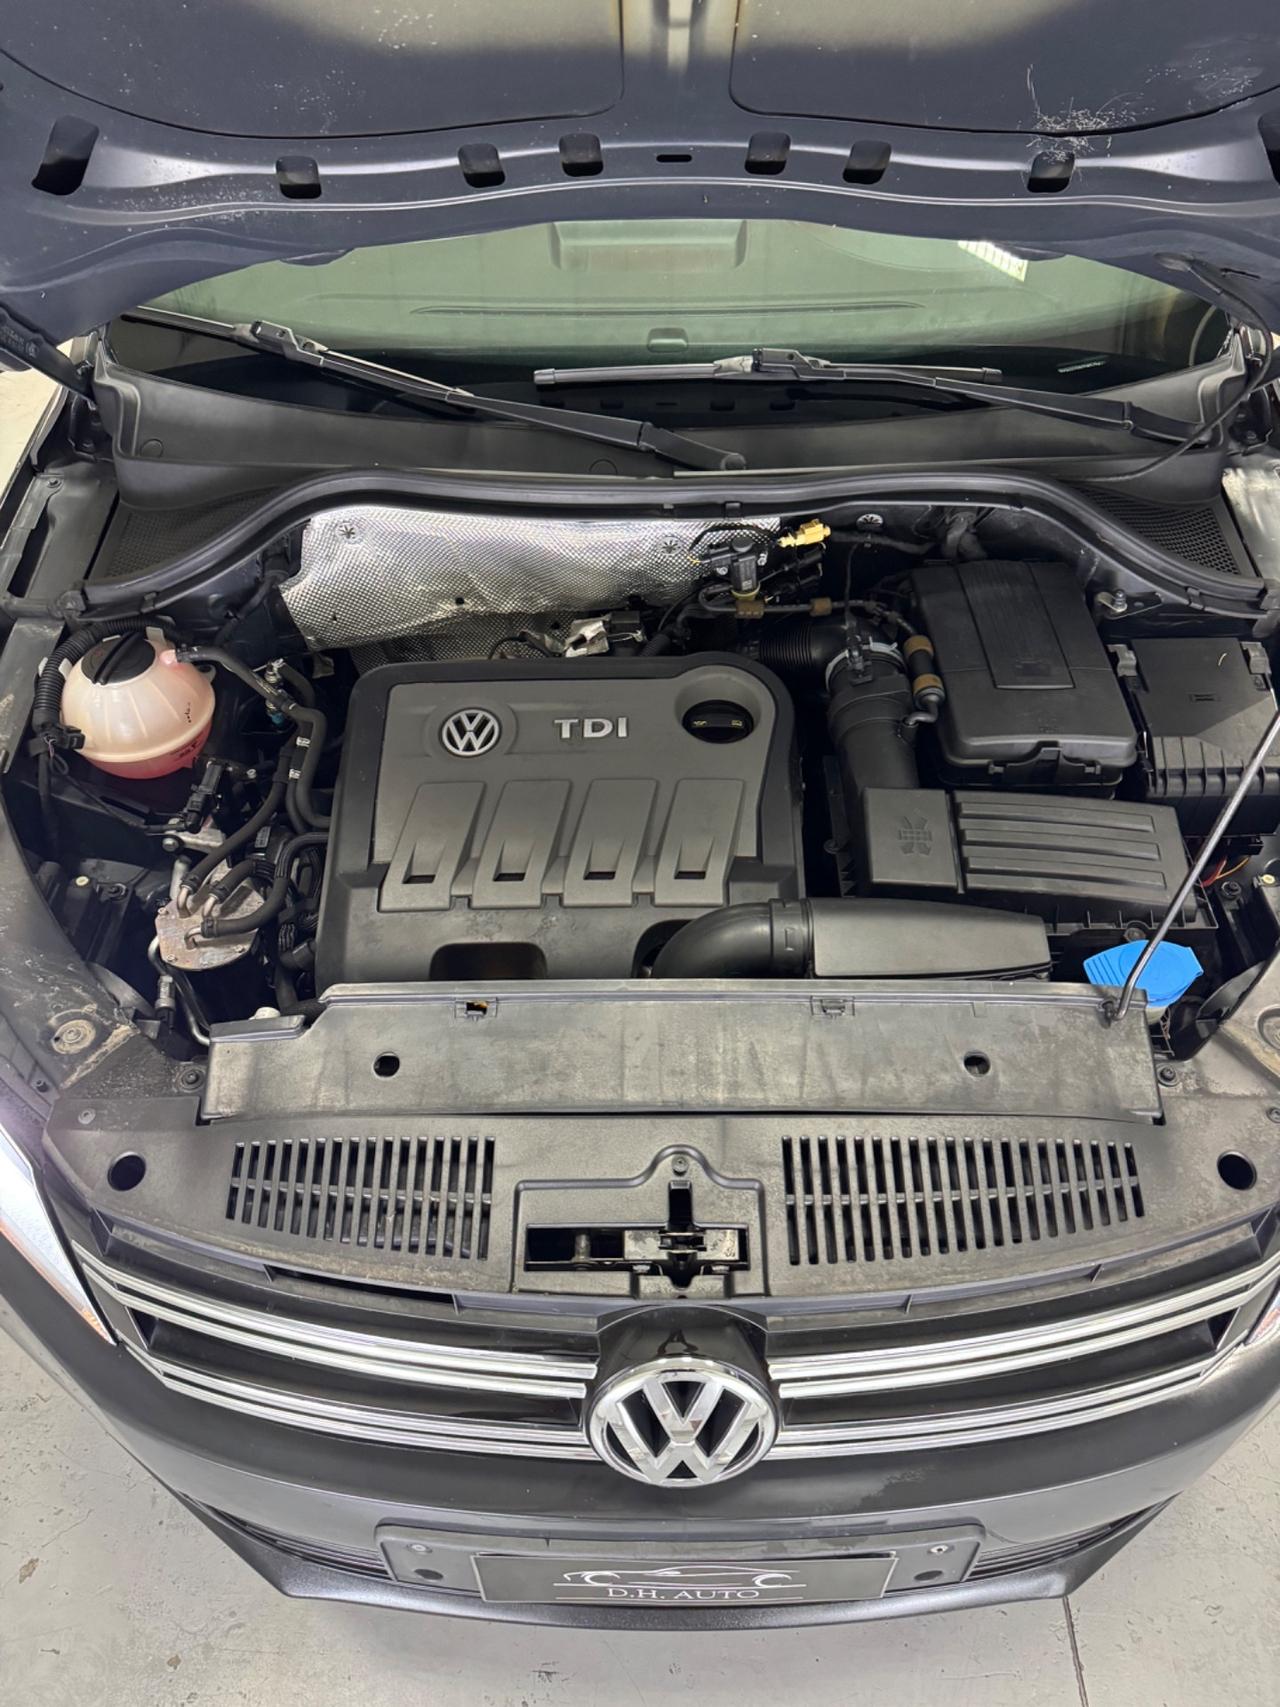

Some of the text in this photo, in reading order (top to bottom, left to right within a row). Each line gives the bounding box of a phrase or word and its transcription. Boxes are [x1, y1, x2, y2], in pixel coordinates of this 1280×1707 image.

[554, 716, 628, 739] TDI
[607, 1587, 760, 1600] D.H. AUTO
